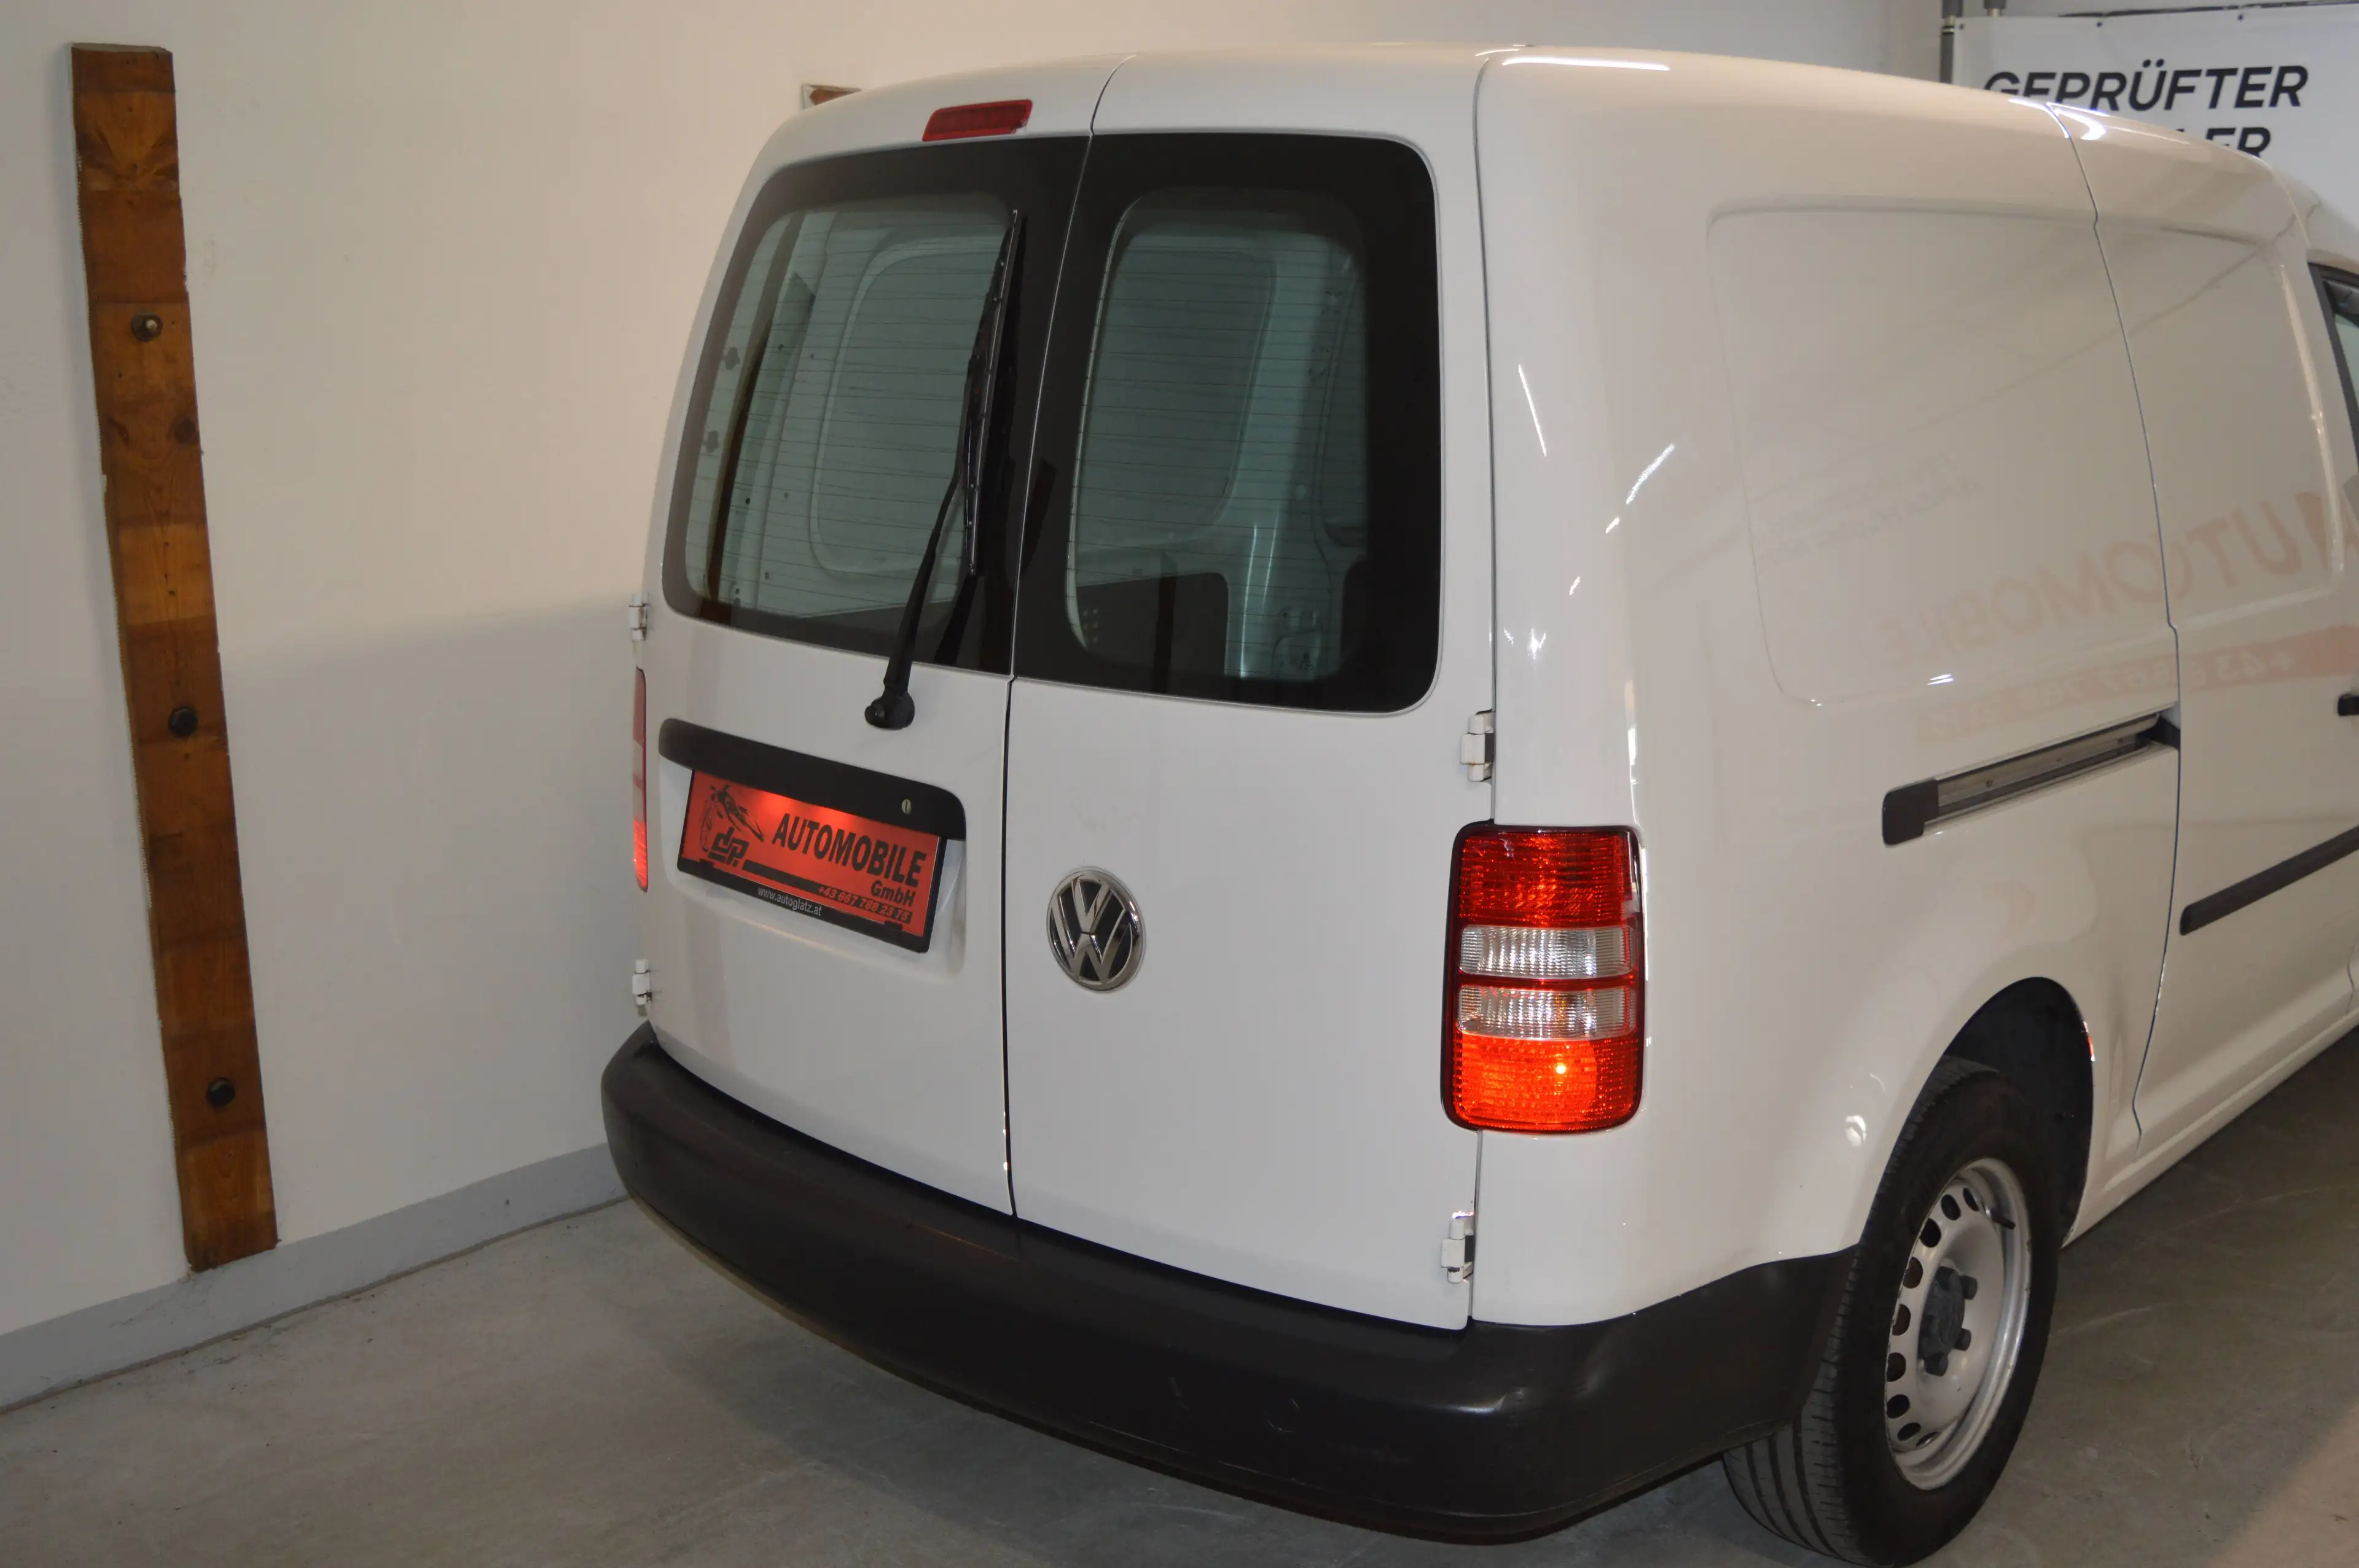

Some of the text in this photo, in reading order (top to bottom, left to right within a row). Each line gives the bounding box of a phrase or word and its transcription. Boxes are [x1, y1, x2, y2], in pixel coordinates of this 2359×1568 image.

[1984, 59, 2308, 111] GEPRÜFTER
[772, 813, 927, 887] AUTOMOBILE
[757, 887, 822, 916] www.autoglatz.at
[818, 886, 836, 899] +43
[838, 891, 859, 905] 667
[880, 905, 894, 918] 23
[870, 880, 916, 907] GmbH
[1048, 870, 1143, 990] VW
